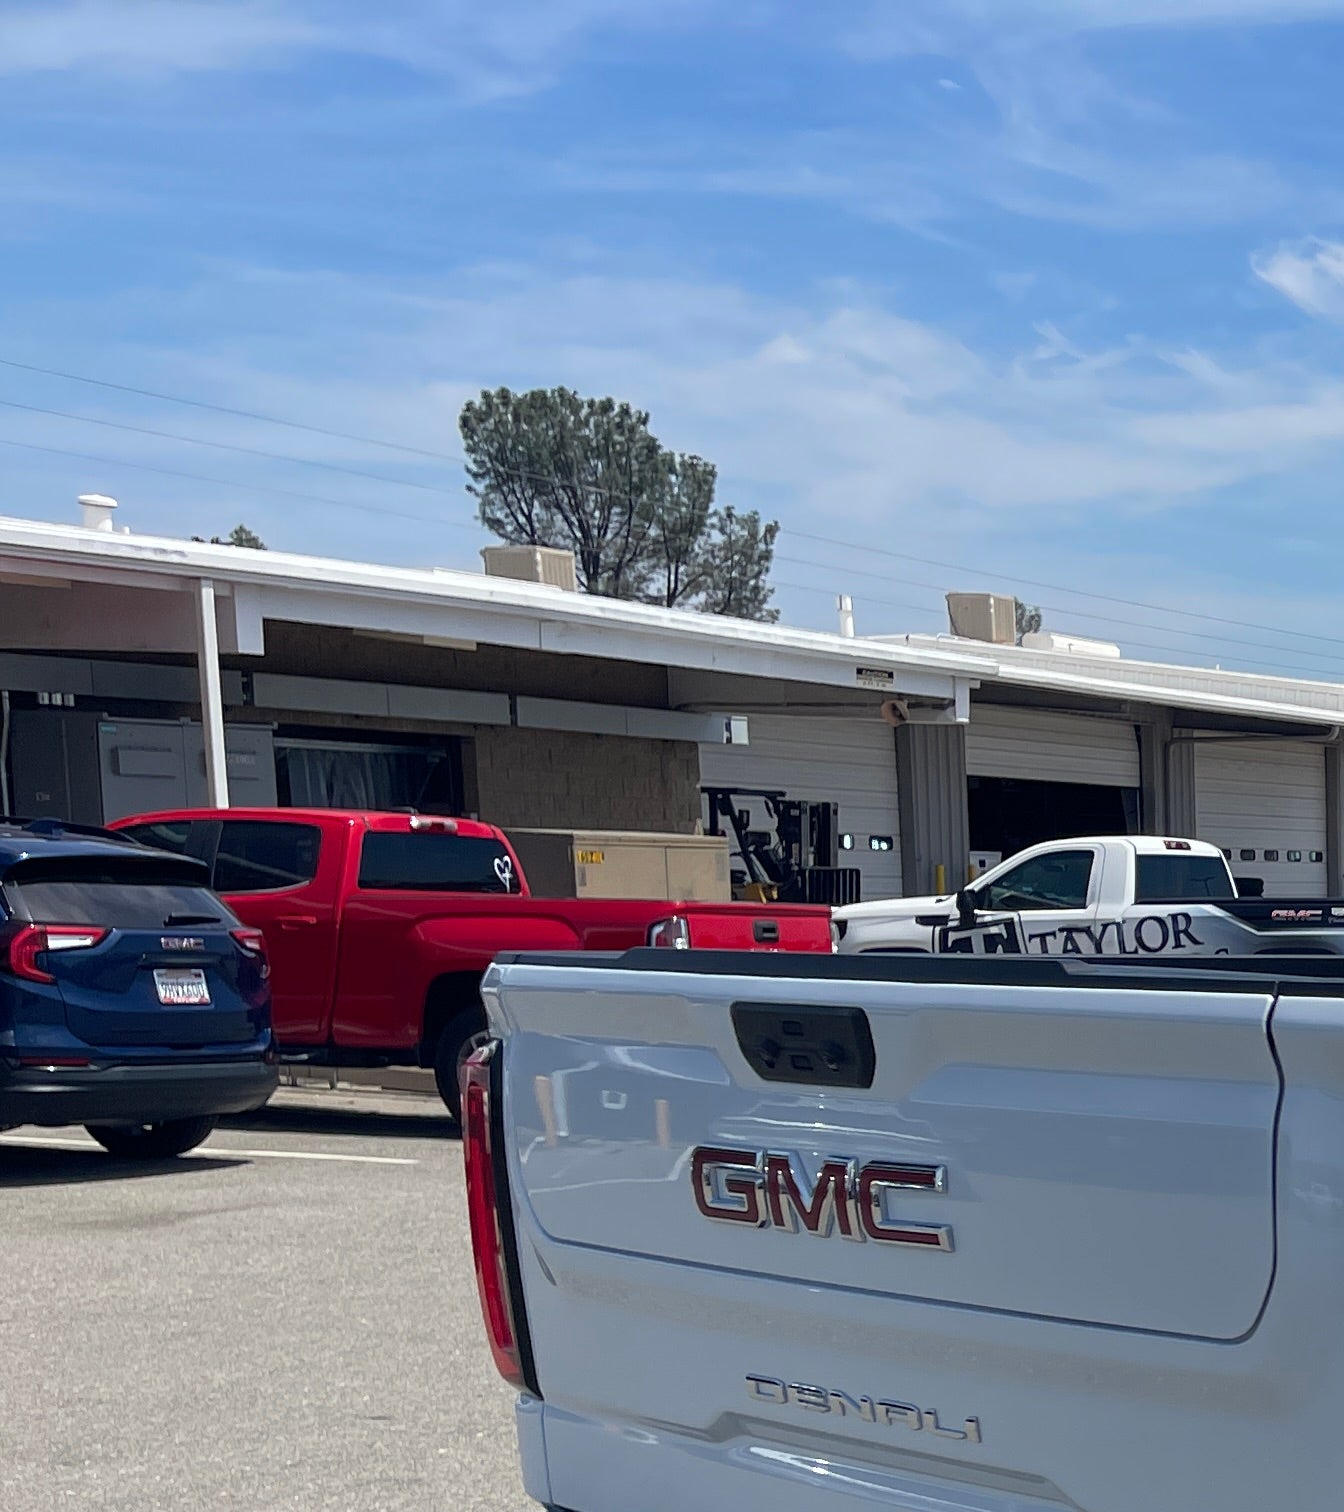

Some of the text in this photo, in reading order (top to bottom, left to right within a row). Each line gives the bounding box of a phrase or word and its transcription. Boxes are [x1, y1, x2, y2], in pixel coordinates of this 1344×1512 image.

[1028, 912, 1204, 954] TAYLOR
[690, 1145, 956, 1253] GMC
[745, 1373, 982, 1443] DENALI
